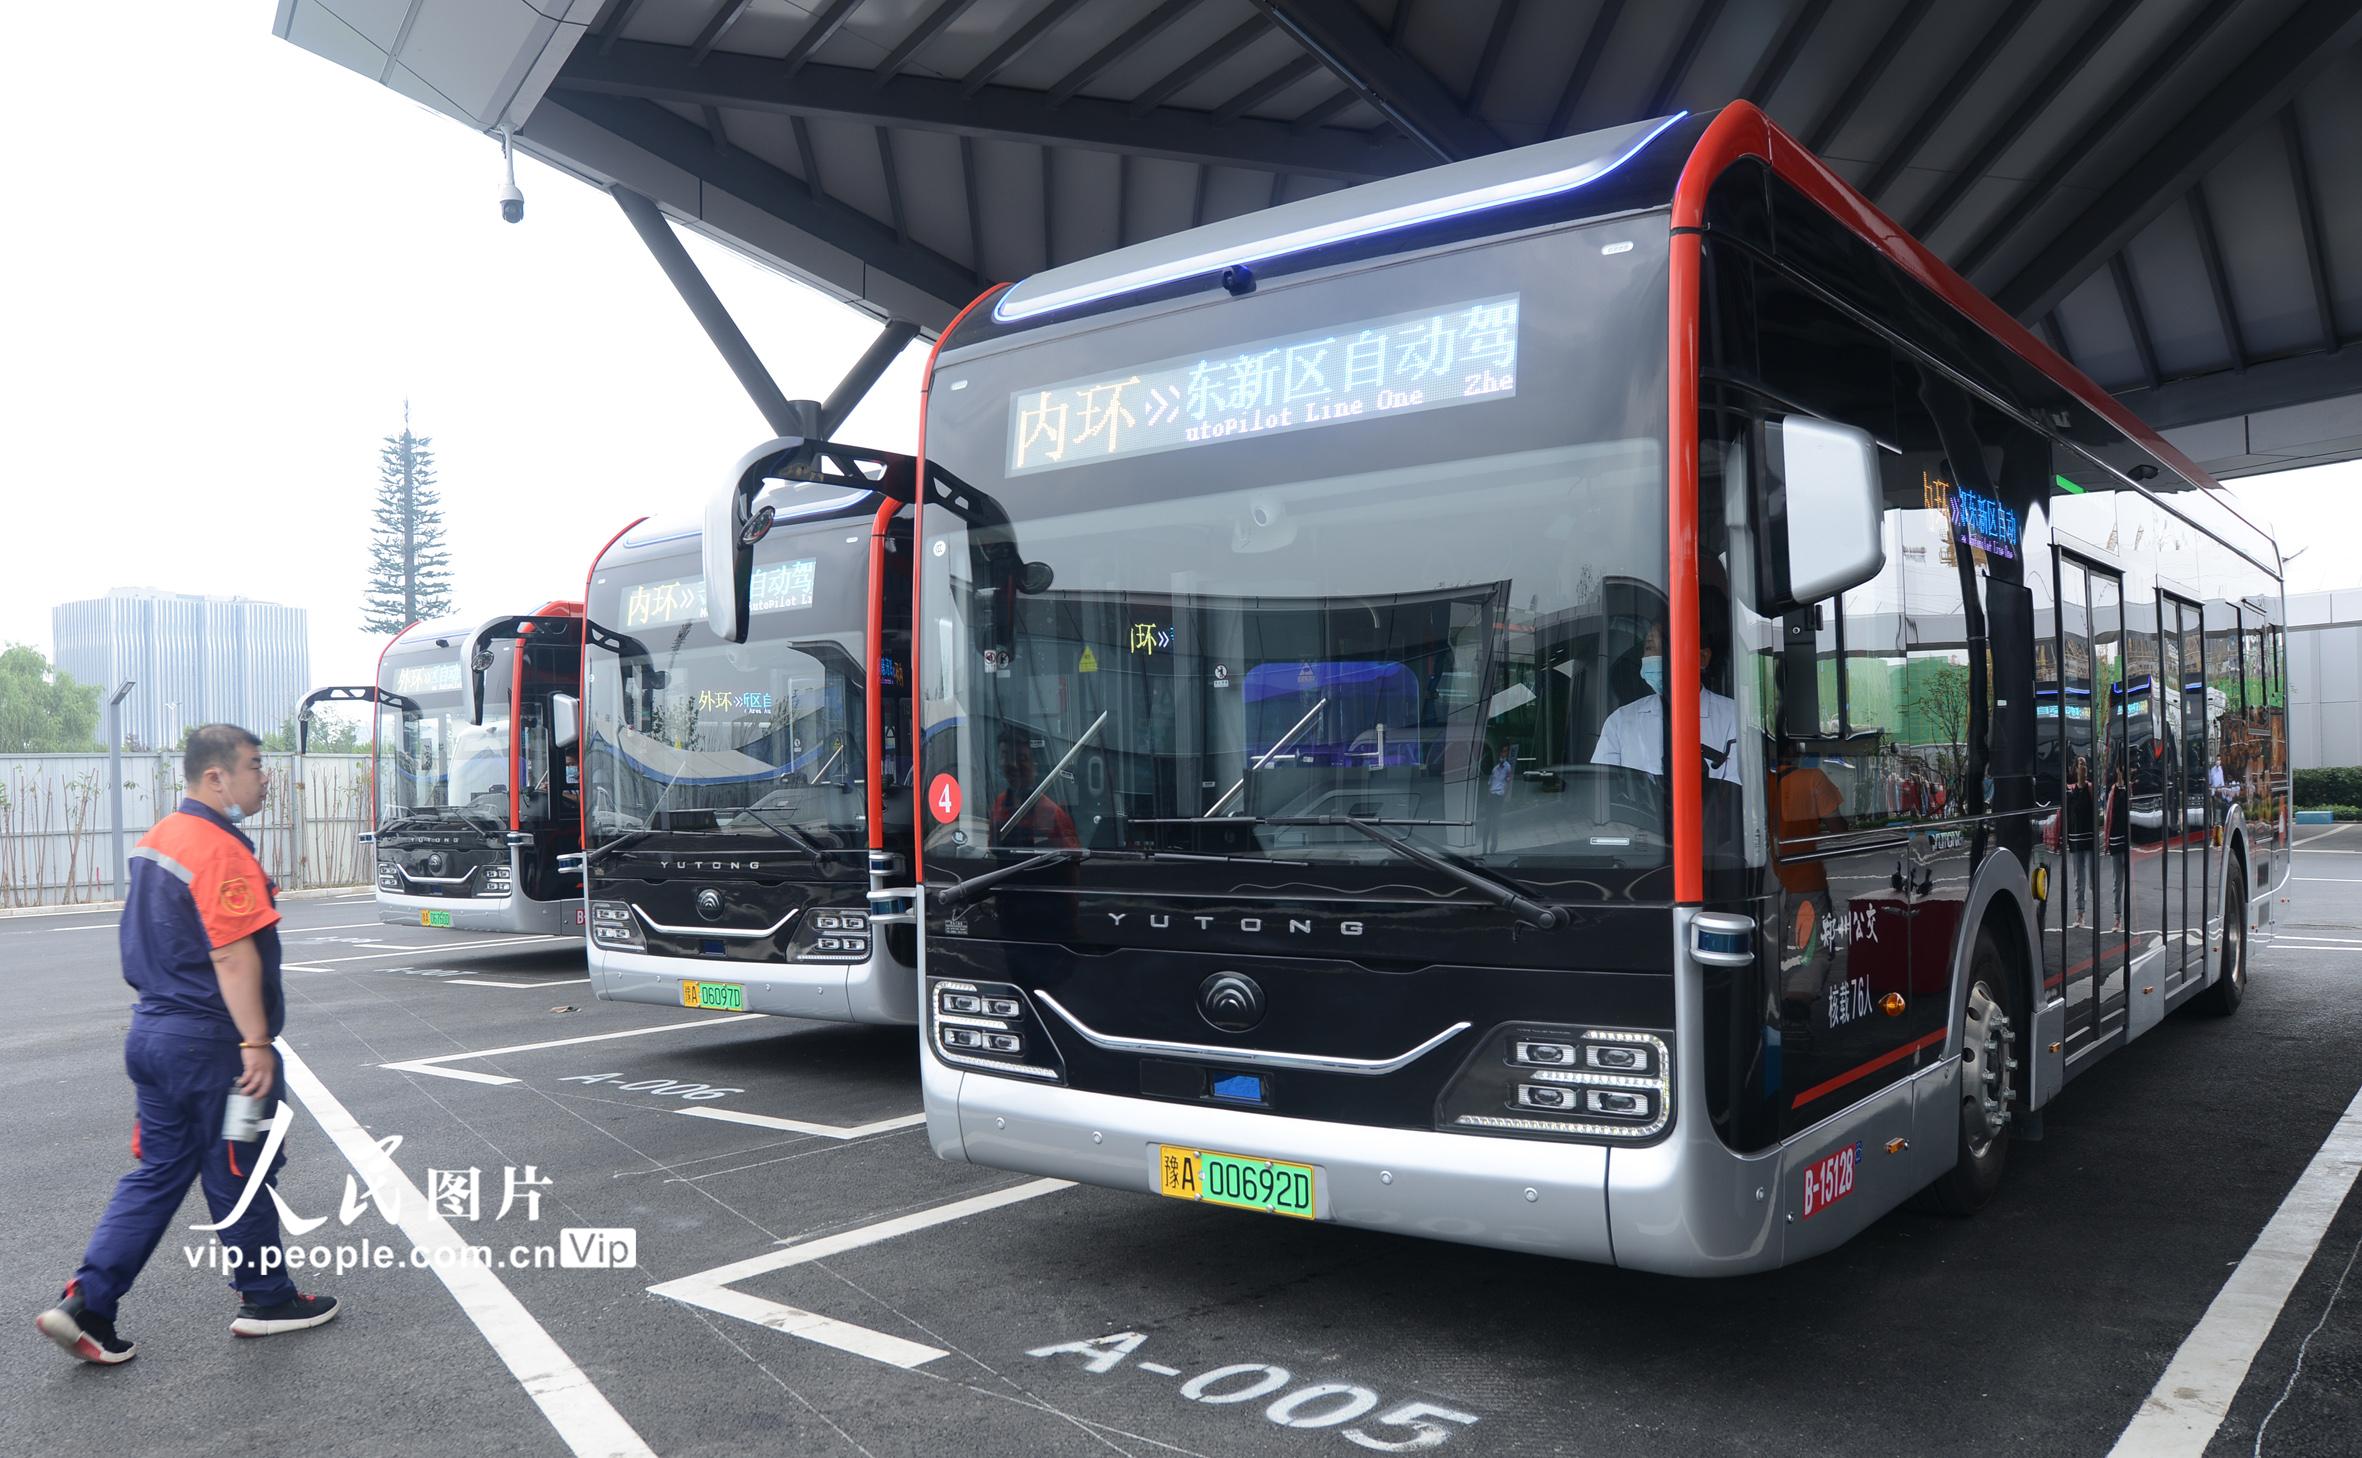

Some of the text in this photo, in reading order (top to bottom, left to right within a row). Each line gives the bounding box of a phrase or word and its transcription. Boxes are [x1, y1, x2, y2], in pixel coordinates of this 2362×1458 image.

[1304, 396, 1364, 423] Line
[1375, 388, 1425, 411] One
[1463, 371, 1514, 396] Zhe
[1016, 375, 1141, 468] 内环
[627, 581, 681, 626] 内环
[699, 690, 732, 713] 外环
[938, 783, 952, 814] 4
[660, 861, 760, 870] YUTONG
[1108, 912, 1363, 935] YUTONG
[1829, 973, 1873, 1029] 核载76人
[557, 1072, 745, 1100] A-006
[1804, 1148, 1854, 1216] B-15128
[1024, 1331, 1480, 1452] A-005
